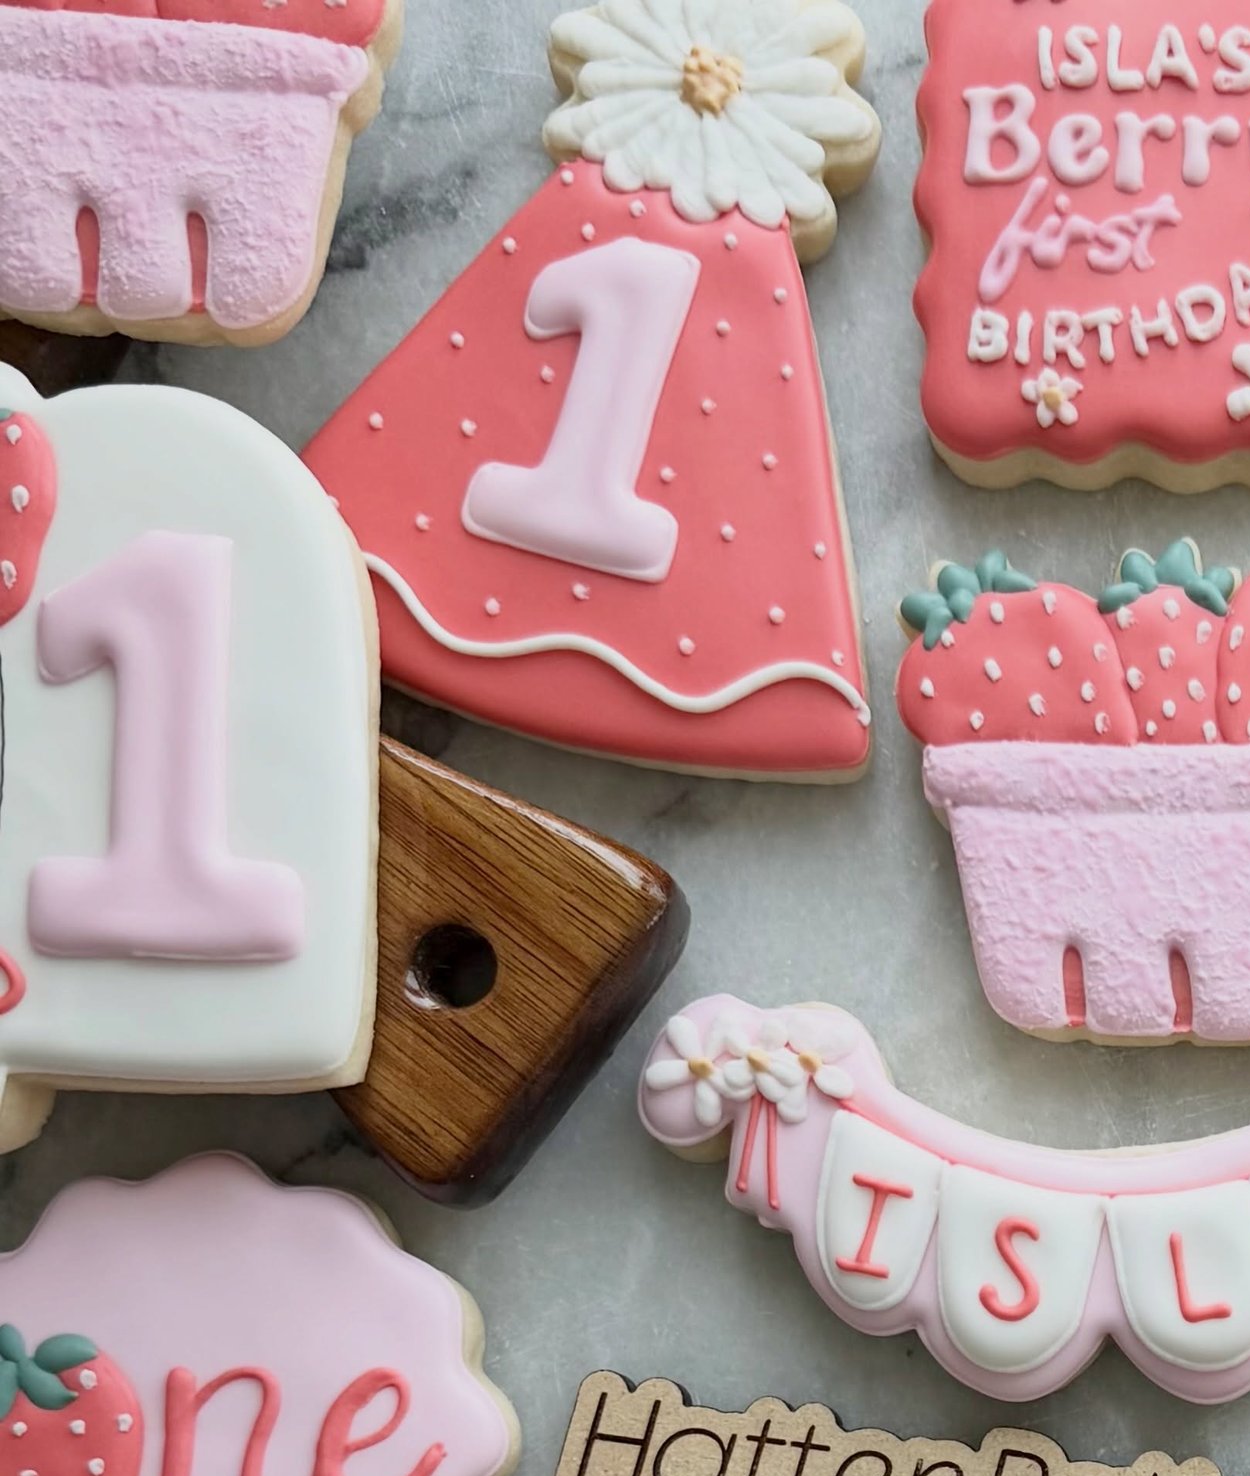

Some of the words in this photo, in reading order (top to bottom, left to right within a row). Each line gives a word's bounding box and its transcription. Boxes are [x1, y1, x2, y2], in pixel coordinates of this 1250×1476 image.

[461, 237, 701, 582] 1
[978, 176, 1182, 302] first
[28, 530, 304, 960] 1
